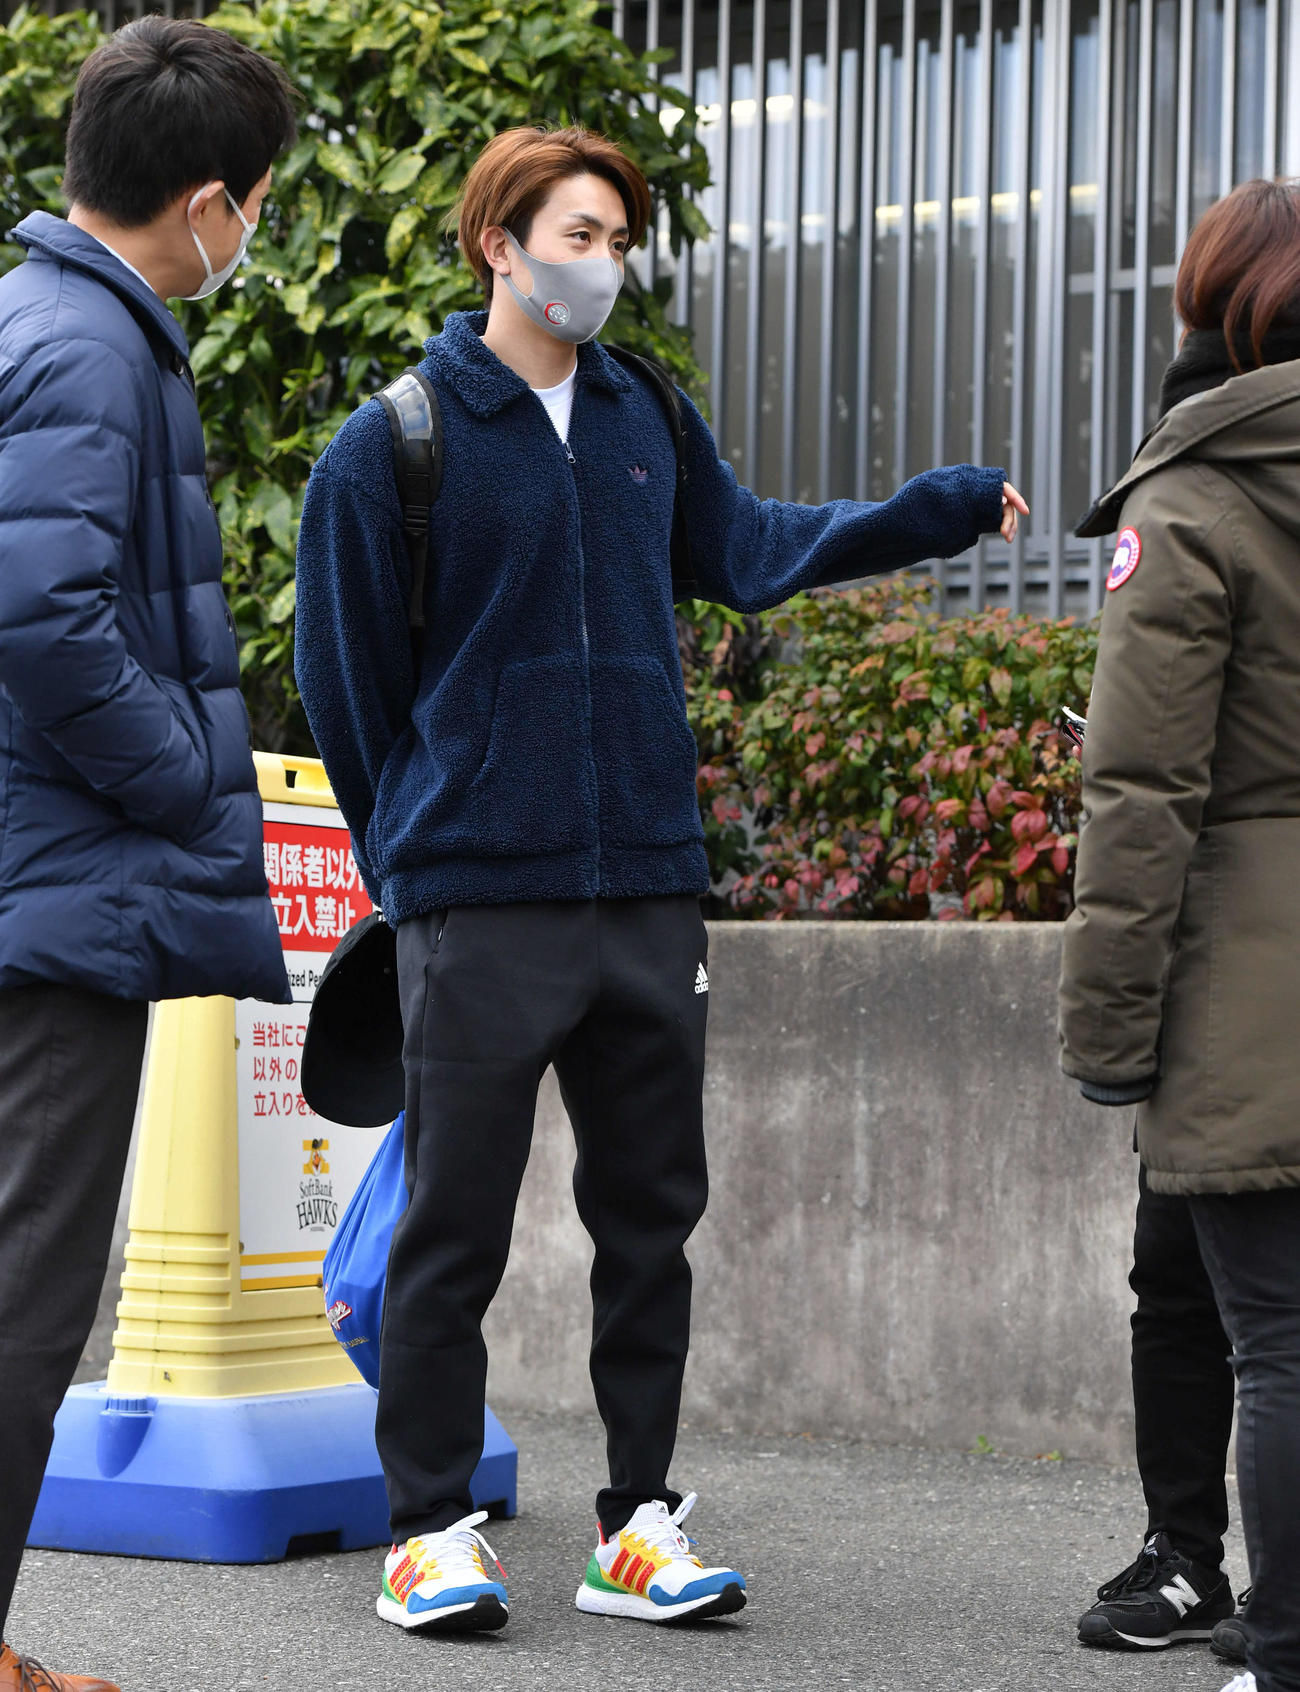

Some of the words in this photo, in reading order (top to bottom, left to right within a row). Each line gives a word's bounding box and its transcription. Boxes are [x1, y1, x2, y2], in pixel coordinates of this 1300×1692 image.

[270, 892, 356, 938] 立入禁止
[288, 969, 306, 987] ized
[253, 1056, 298, 1082] 以外の
[254, 1092, 318, 1117] 立入りを
[299, 1178, 333, 1199] SoftBank
[296, 1198, 338, 1229] HAWKS
[1159, 1574, 1201, 1618] N
